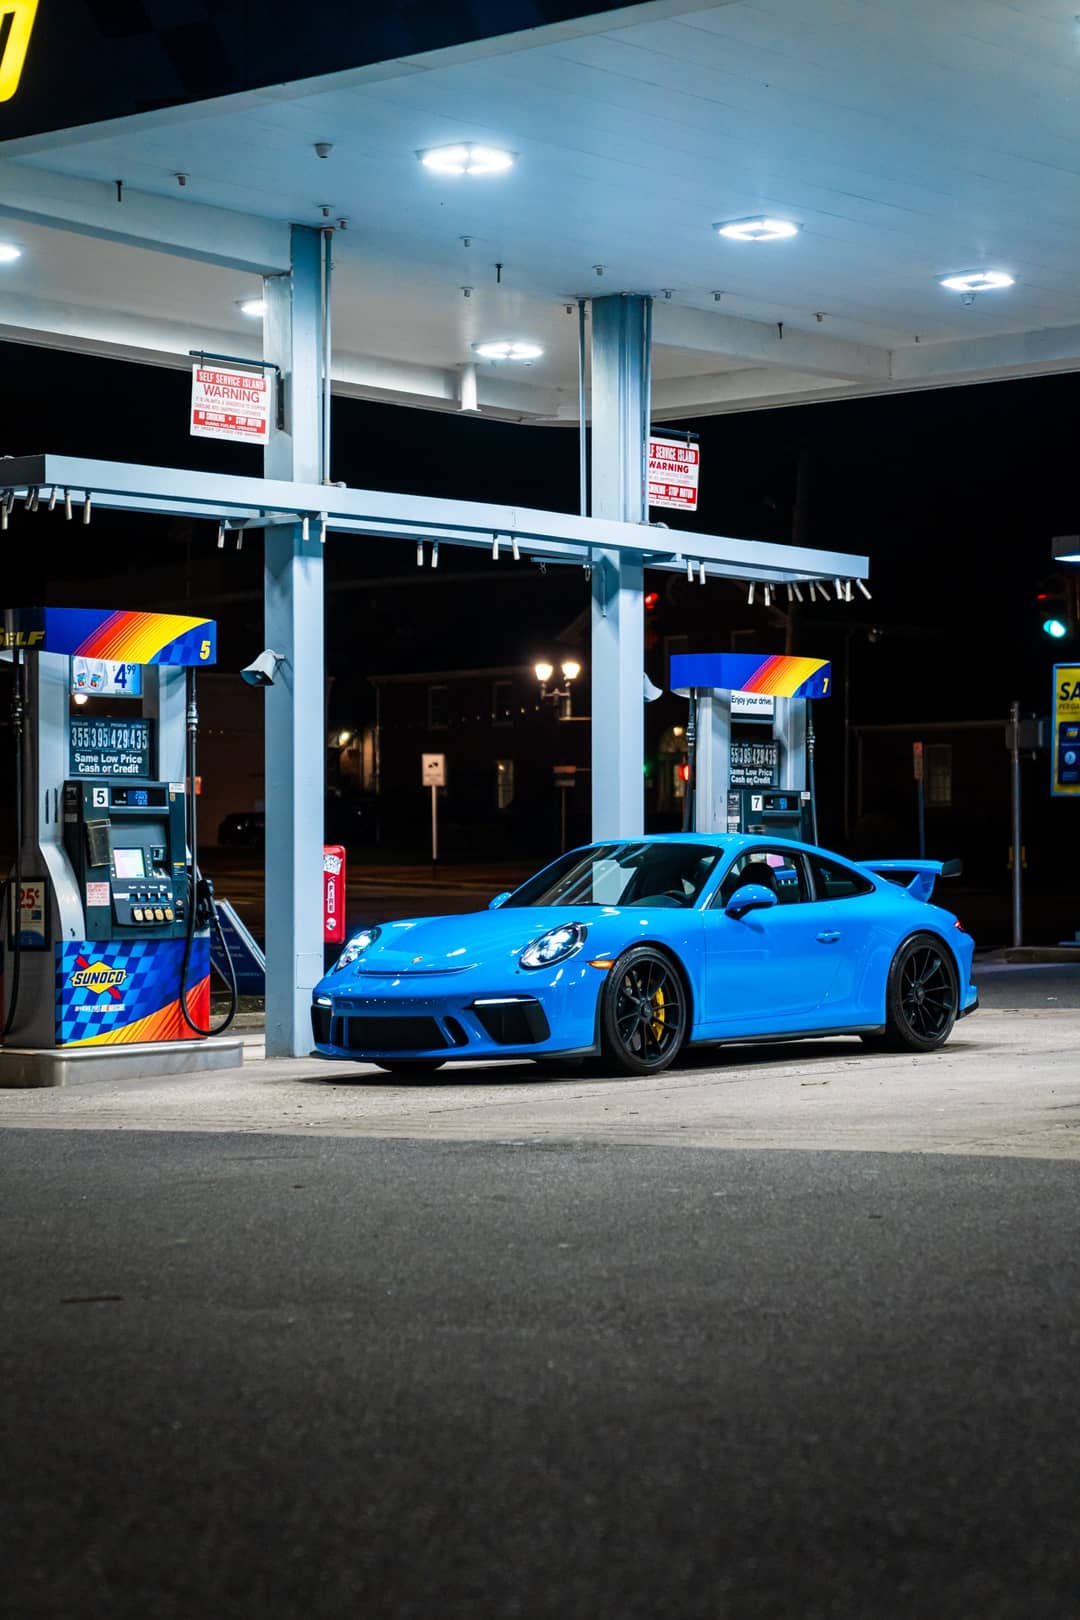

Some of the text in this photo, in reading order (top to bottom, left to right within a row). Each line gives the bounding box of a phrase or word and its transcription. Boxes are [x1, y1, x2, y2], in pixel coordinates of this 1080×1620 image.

[199, 371, 264, 391] SELF SERVICE ISLAND
[203, 384, 260, 403] WARNING
[649, 460, 689, 474] WARNING
[200, 640, 211, 660] 5
[731, 695, 745, 706] Enjoy
[746, 697, 757, 706] your
[71, 727, 147, 750] 355 395 429 435
[74, 753, 143, 764] Same Low Price
[78, 764, 100, 773] Cash
[113, 764, 139, 774] Credit
[745, 768, 758, 776] Low
[731, 775, 746, 783] Cash
[96, 790, 106, 806] 5
[753, 797, 760, 809] 7
[327, 883, 335, 911] FIRE
[74, 971, 124, 985] SUNOCO
